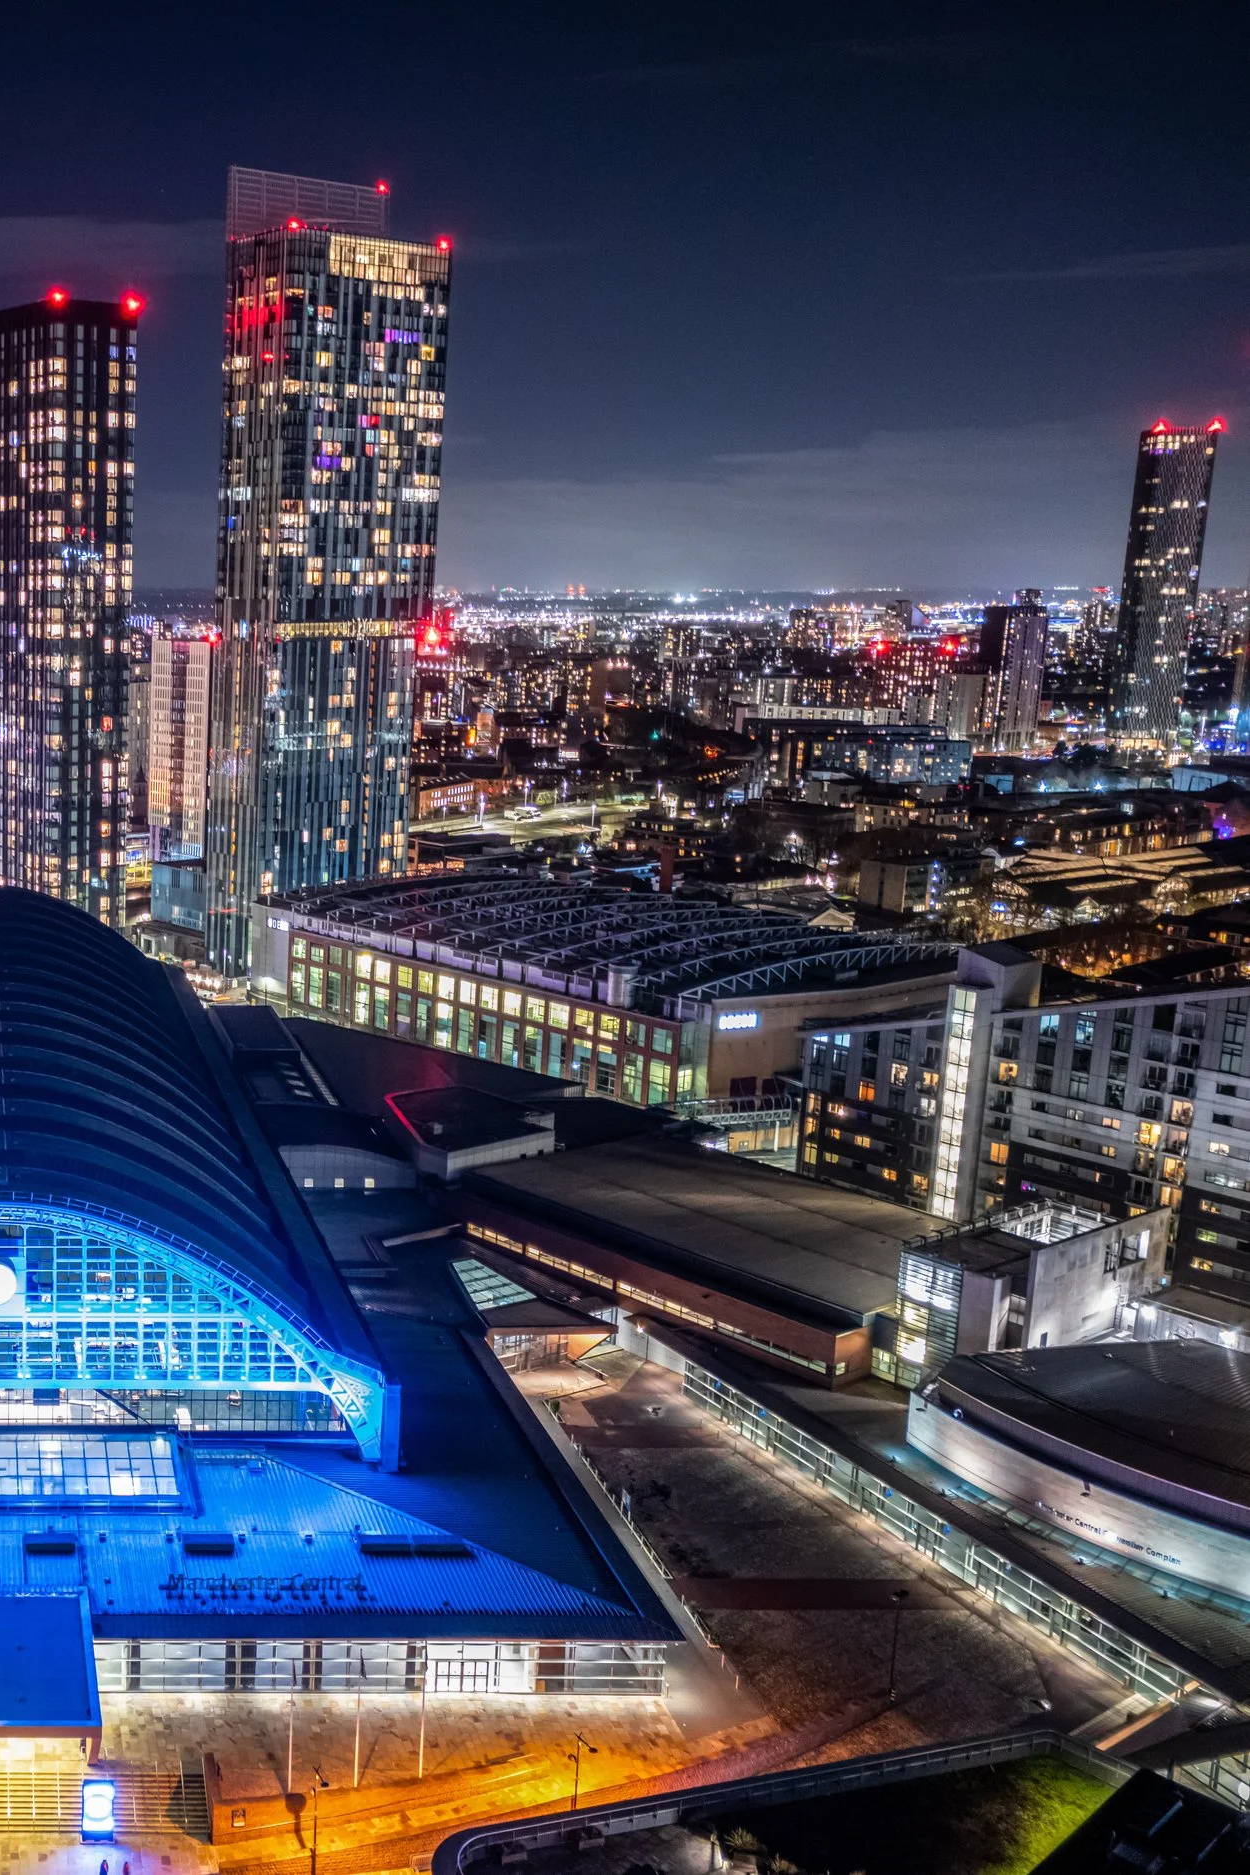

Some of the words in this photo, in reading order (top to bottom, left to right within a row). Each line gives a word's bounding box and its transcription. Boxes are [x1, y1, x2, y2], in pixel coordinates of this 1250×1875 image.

[1075, 1518, 1102, 1535] Central
[1145, 1547, 1182, 1566] Complex
[168, 1573, 282, 1591] Manchester
[291, 1572, 362, 1591] Central
